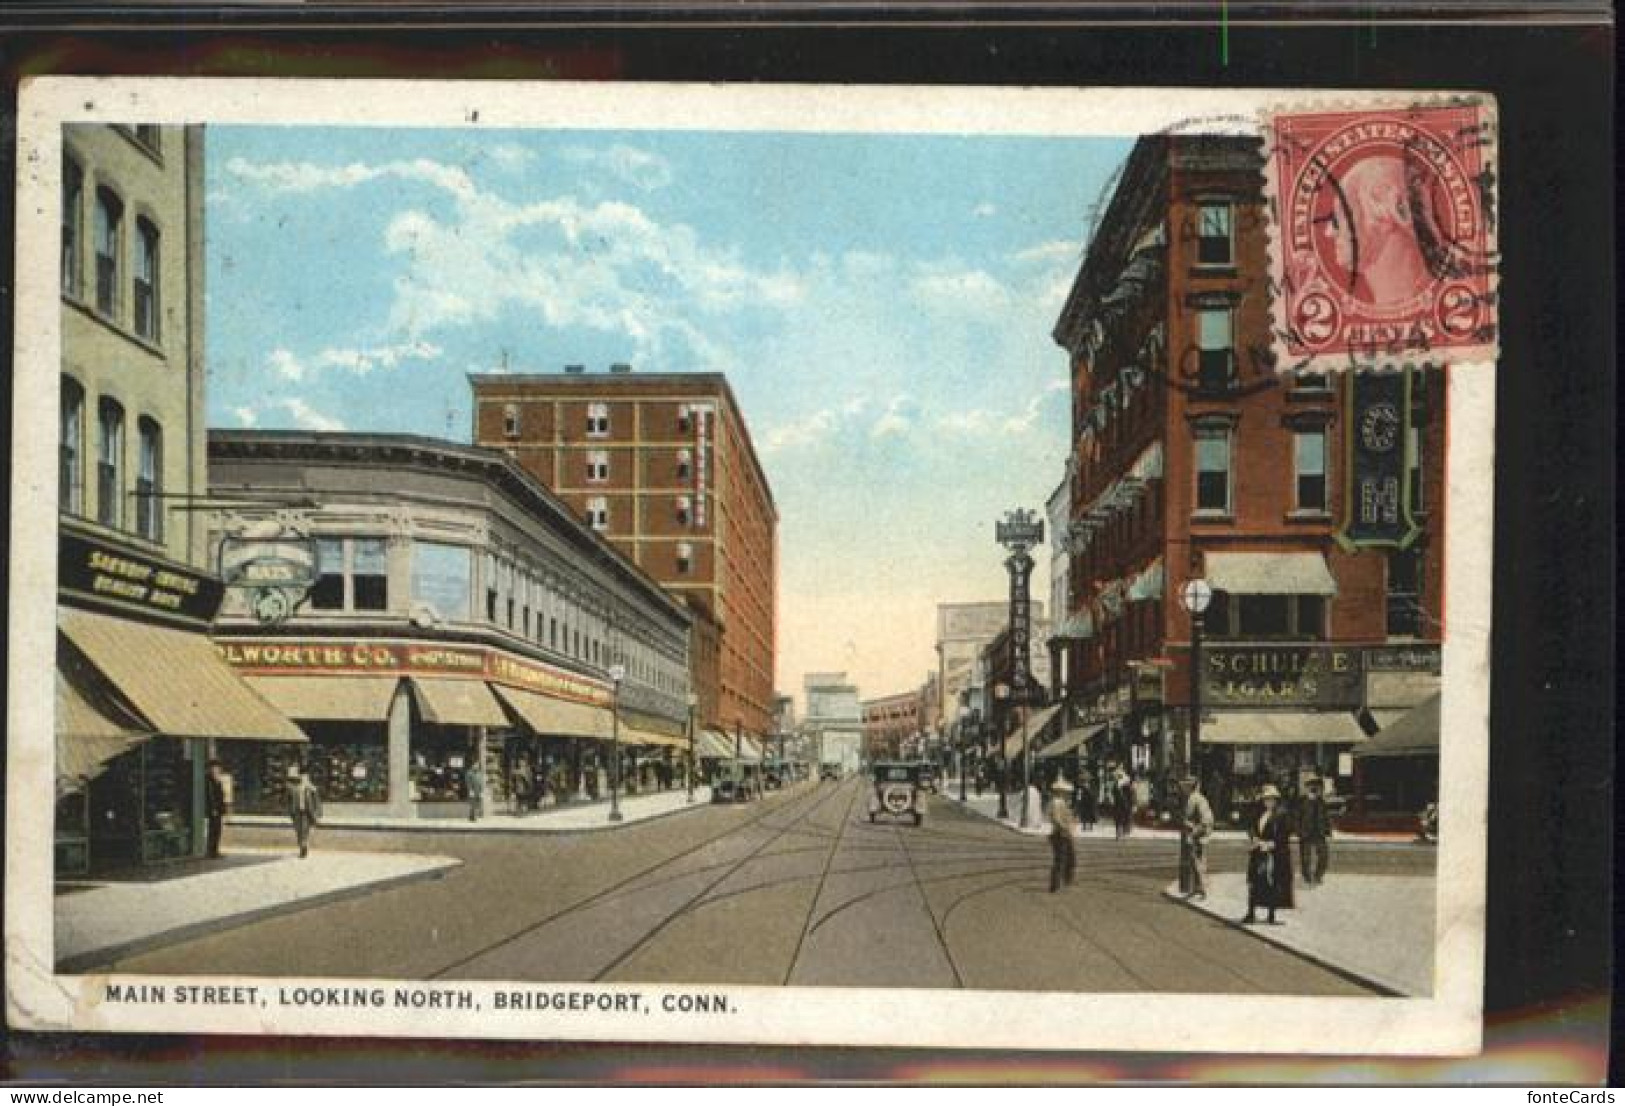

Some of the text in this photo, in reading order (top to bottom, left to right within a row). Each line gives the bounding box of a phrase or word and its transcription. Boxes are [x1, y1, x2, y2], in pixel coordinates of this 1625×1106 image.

[1302, 296, 1332, 339] 2
[1443, 291, 1474, 331] 2
[352, 644, 397, 666] CO.
[105, 984, 738, 1014] MAIN STREET, LOOKING NORTH, BRIDGEPORT, CONN.
